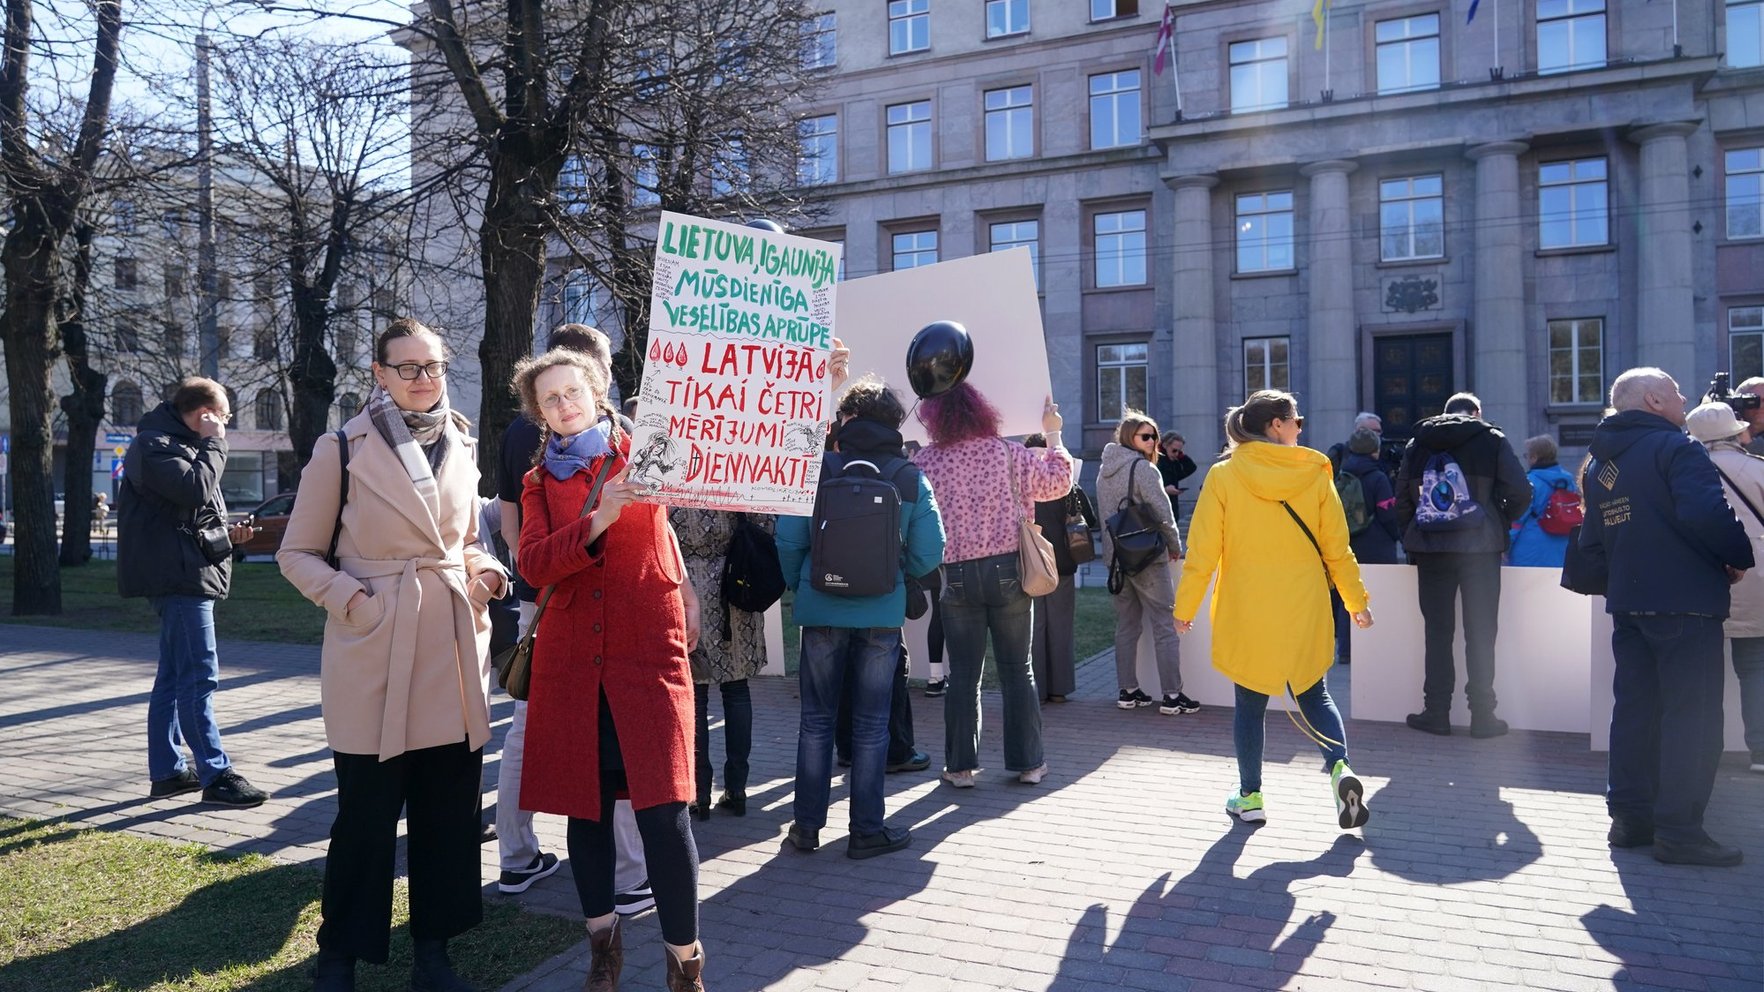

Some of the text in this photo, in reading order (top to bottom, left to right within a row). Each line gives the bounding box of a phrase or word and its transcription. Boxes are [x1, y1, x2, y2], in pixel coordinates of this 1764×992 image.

[759, 238, 836, 289] IGAUNIJA
[674, 267, 809, 312] MŪSDIENĪGA
[662, 299, 831, 350] VESELĪBAS APRŪPE
[701, 342, 815, 383] LATVIJĀ
[666, 376, 747, 412] TIKAI
[757, 381, 824, 422] ČETRI
[669, 413, 787, 448] MĒRĪJUMI
[685, 443, 815, 489] DIENNAKTĪ
